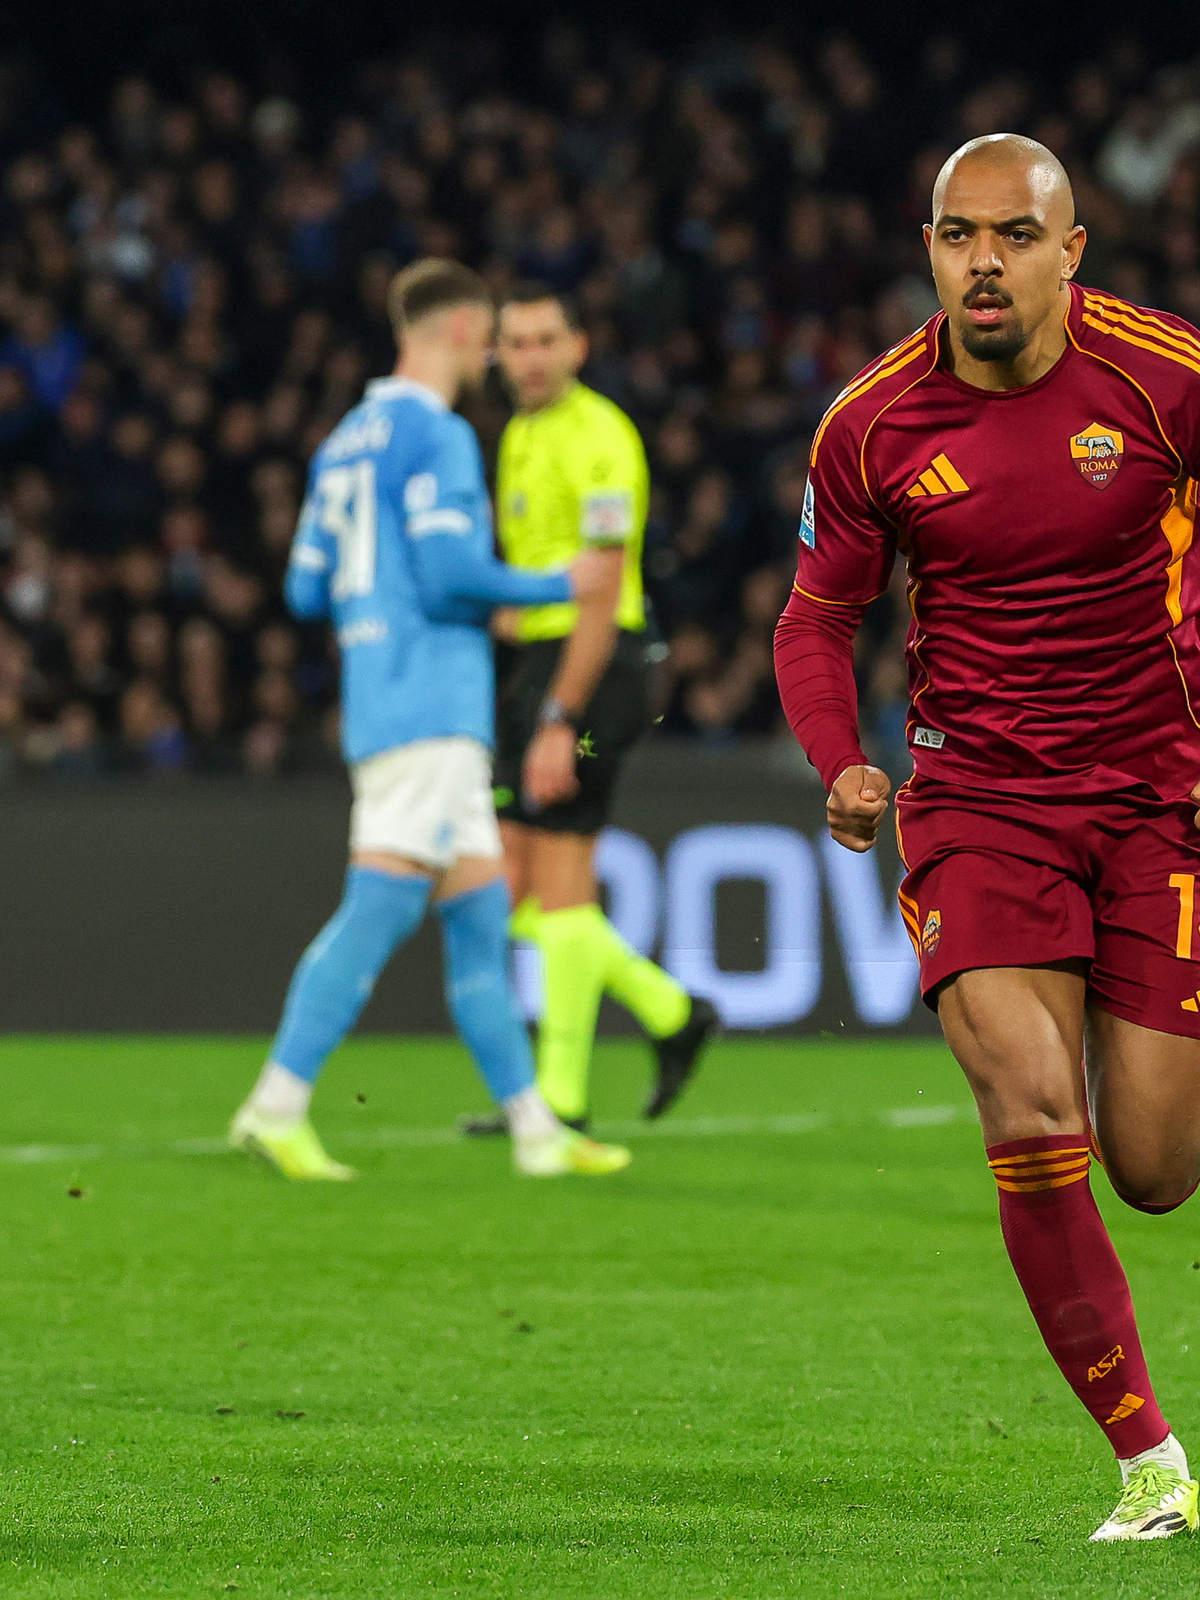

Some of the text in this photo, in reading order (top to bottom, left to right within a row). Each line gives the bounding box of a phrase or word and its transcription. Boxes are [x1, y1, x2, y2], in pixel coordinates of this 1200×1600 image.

[1080, 460, 1119, 473] ROMA
[1092, 473, 1108, 481] 1927
[1088, 1344, 1126, 1383] ASR
